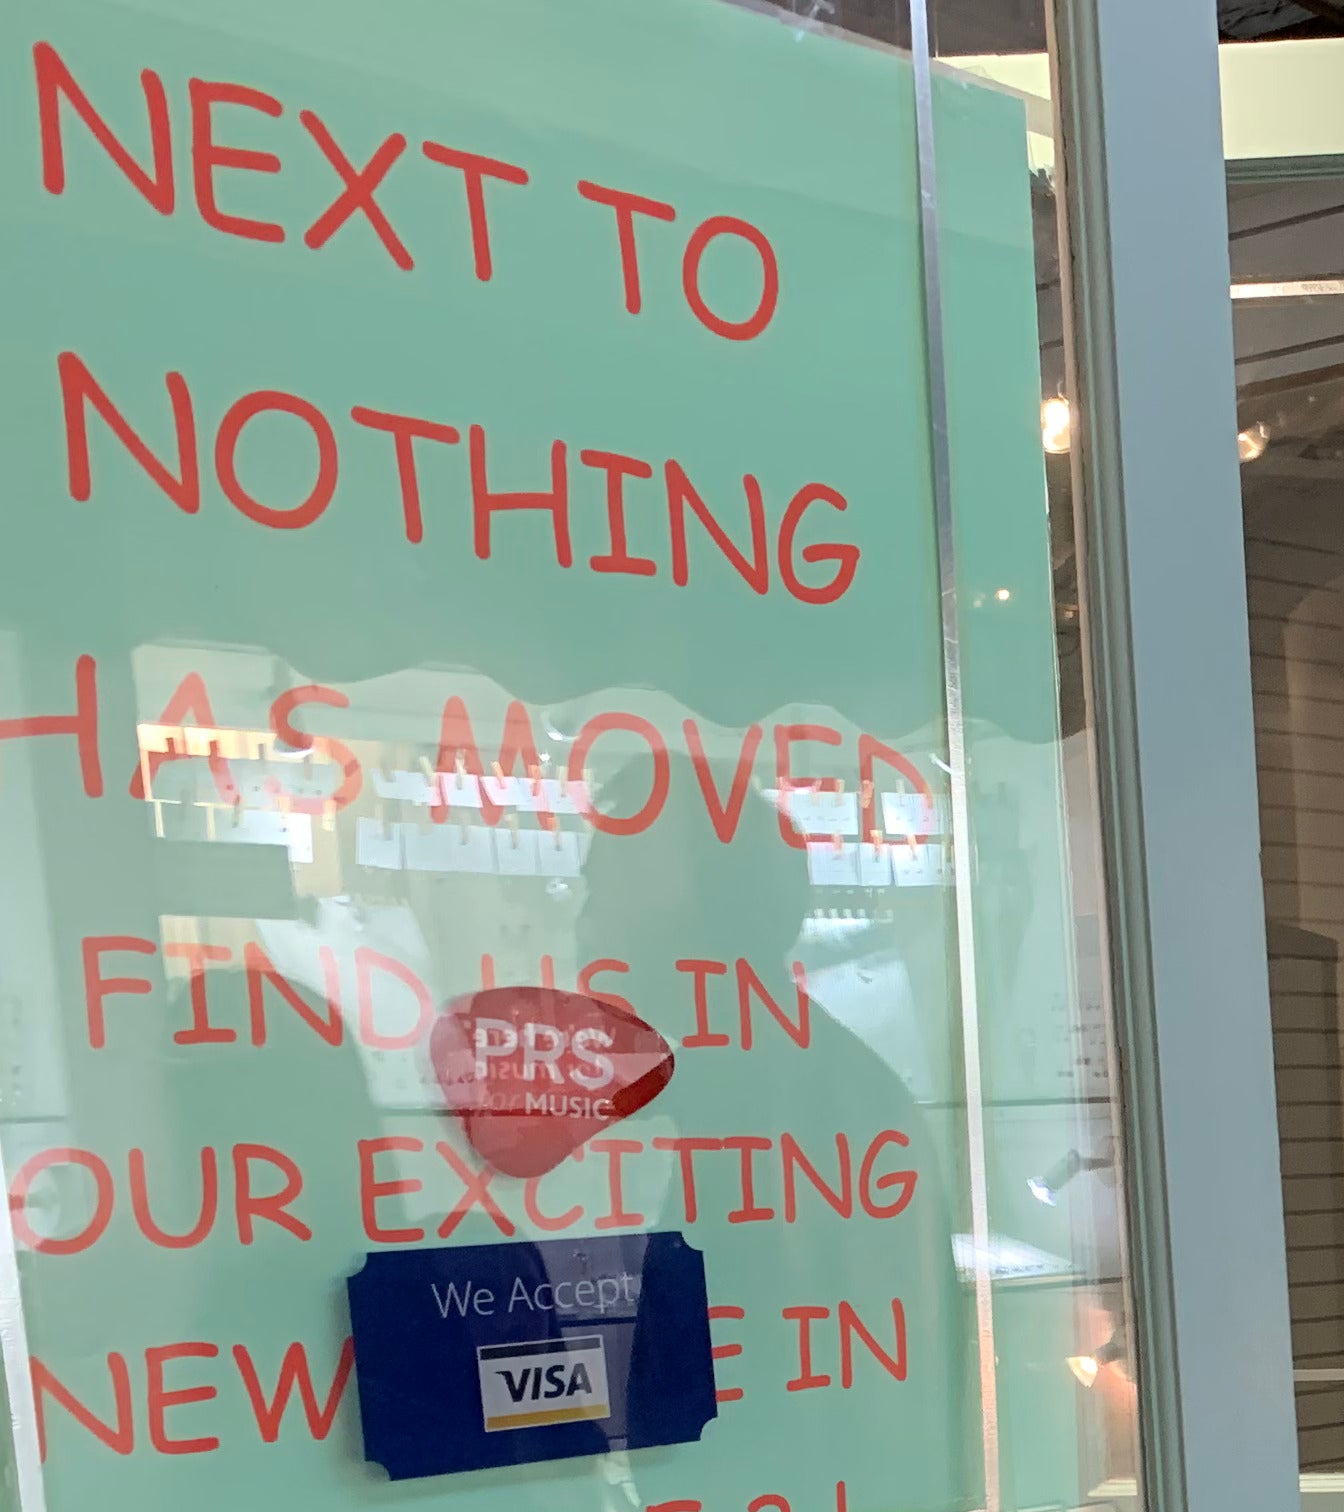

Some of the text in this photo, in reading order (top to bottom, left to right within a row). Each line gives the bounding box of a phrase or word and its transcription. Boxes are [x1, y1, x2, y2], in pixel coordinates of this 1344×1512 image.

[32, 41, 779, 341] NEXT TO
[57, 351, 860, 605] NOTHING
[0, 653, 934, 850] HAS MOVED
[82, 935, 434, 1050] FIND
[675, 957, 811, 1050] IN
[474, 1017, 614, 1090] PRS
[525, 1091, 612, 1121] MUSIC
[9, 1129, 917, 1255] OUR EXCITING
[430, 1267, 640, 1320] We Accept
[30, 1340, 354, 1458] NEW
[785, 1297, 907, 1394] IN
[494, 1367, 593, 1403] VISA
